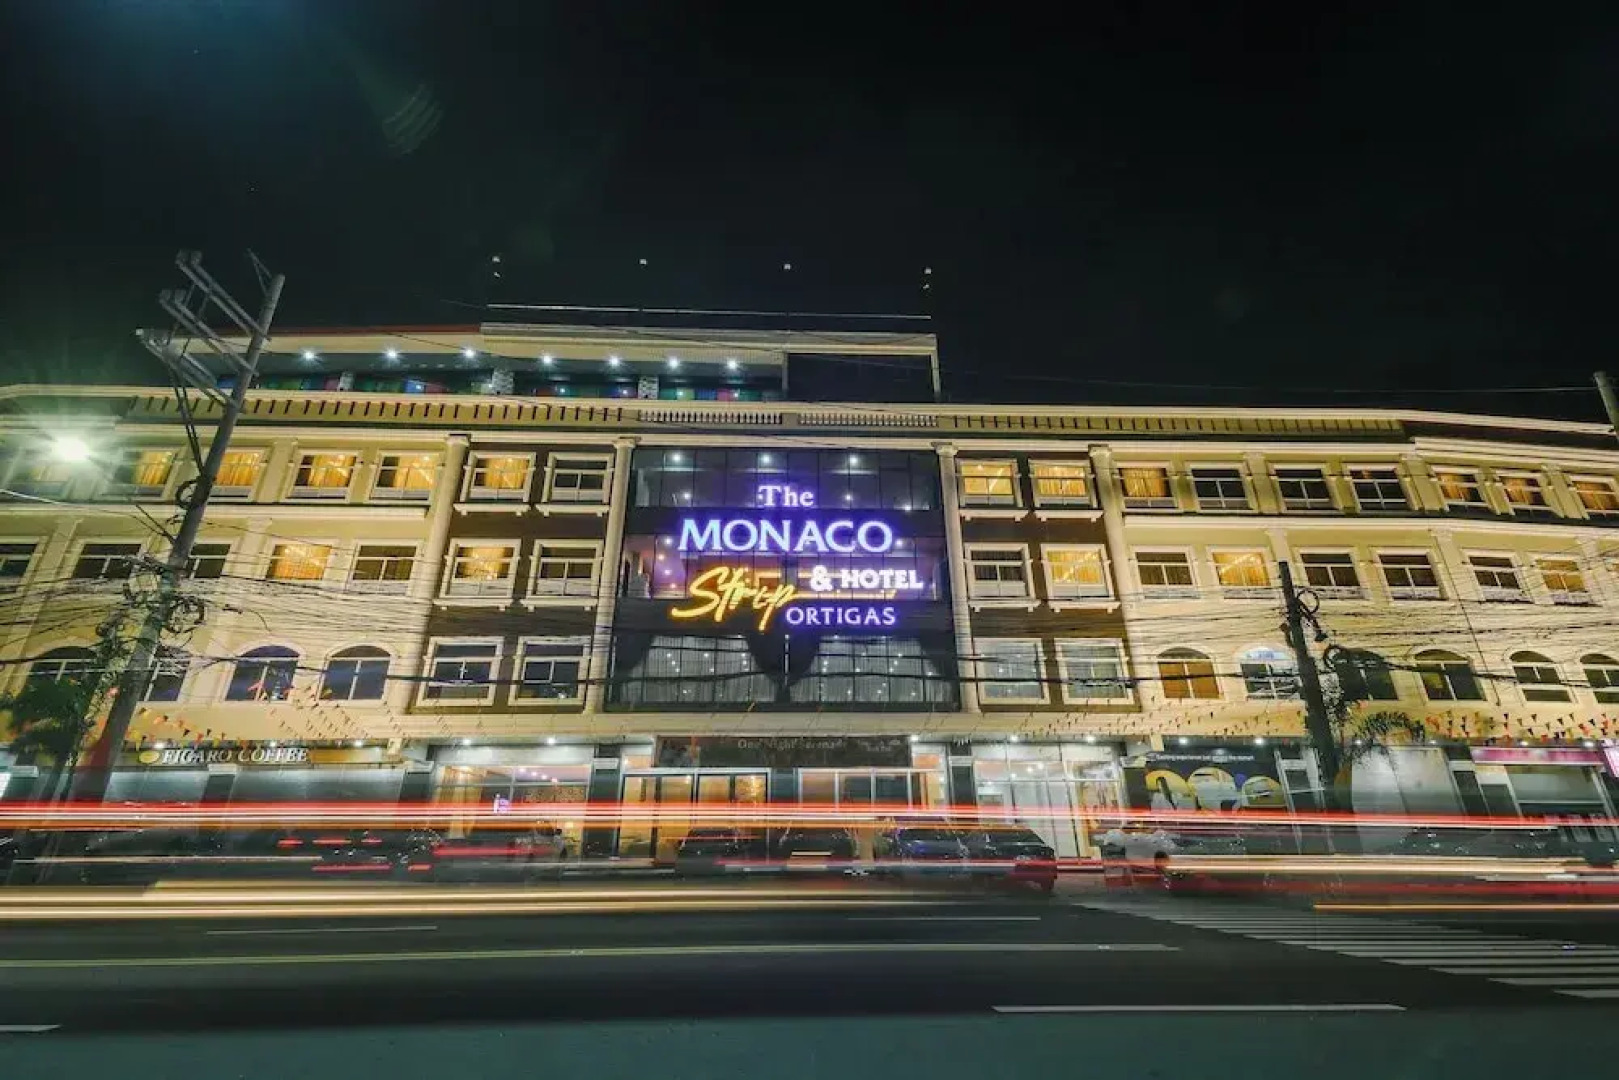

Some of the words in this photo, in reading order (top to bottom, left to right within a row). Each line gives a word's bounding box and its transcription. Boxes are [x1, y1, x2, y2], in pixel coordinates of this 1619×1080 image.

[759, 485, 814, 507] The
[678, 519, 893, 552] MONACO
[671, 566, 797, 631] Strip
[809, 565, 833, 591] &
[841, 569, 923, 589] HOTEL
[786, 607, 896, 625] ORTIGAS
[162, 749, 232, 764] FIGARO
[238, 748, 309, 763] COFFEE
